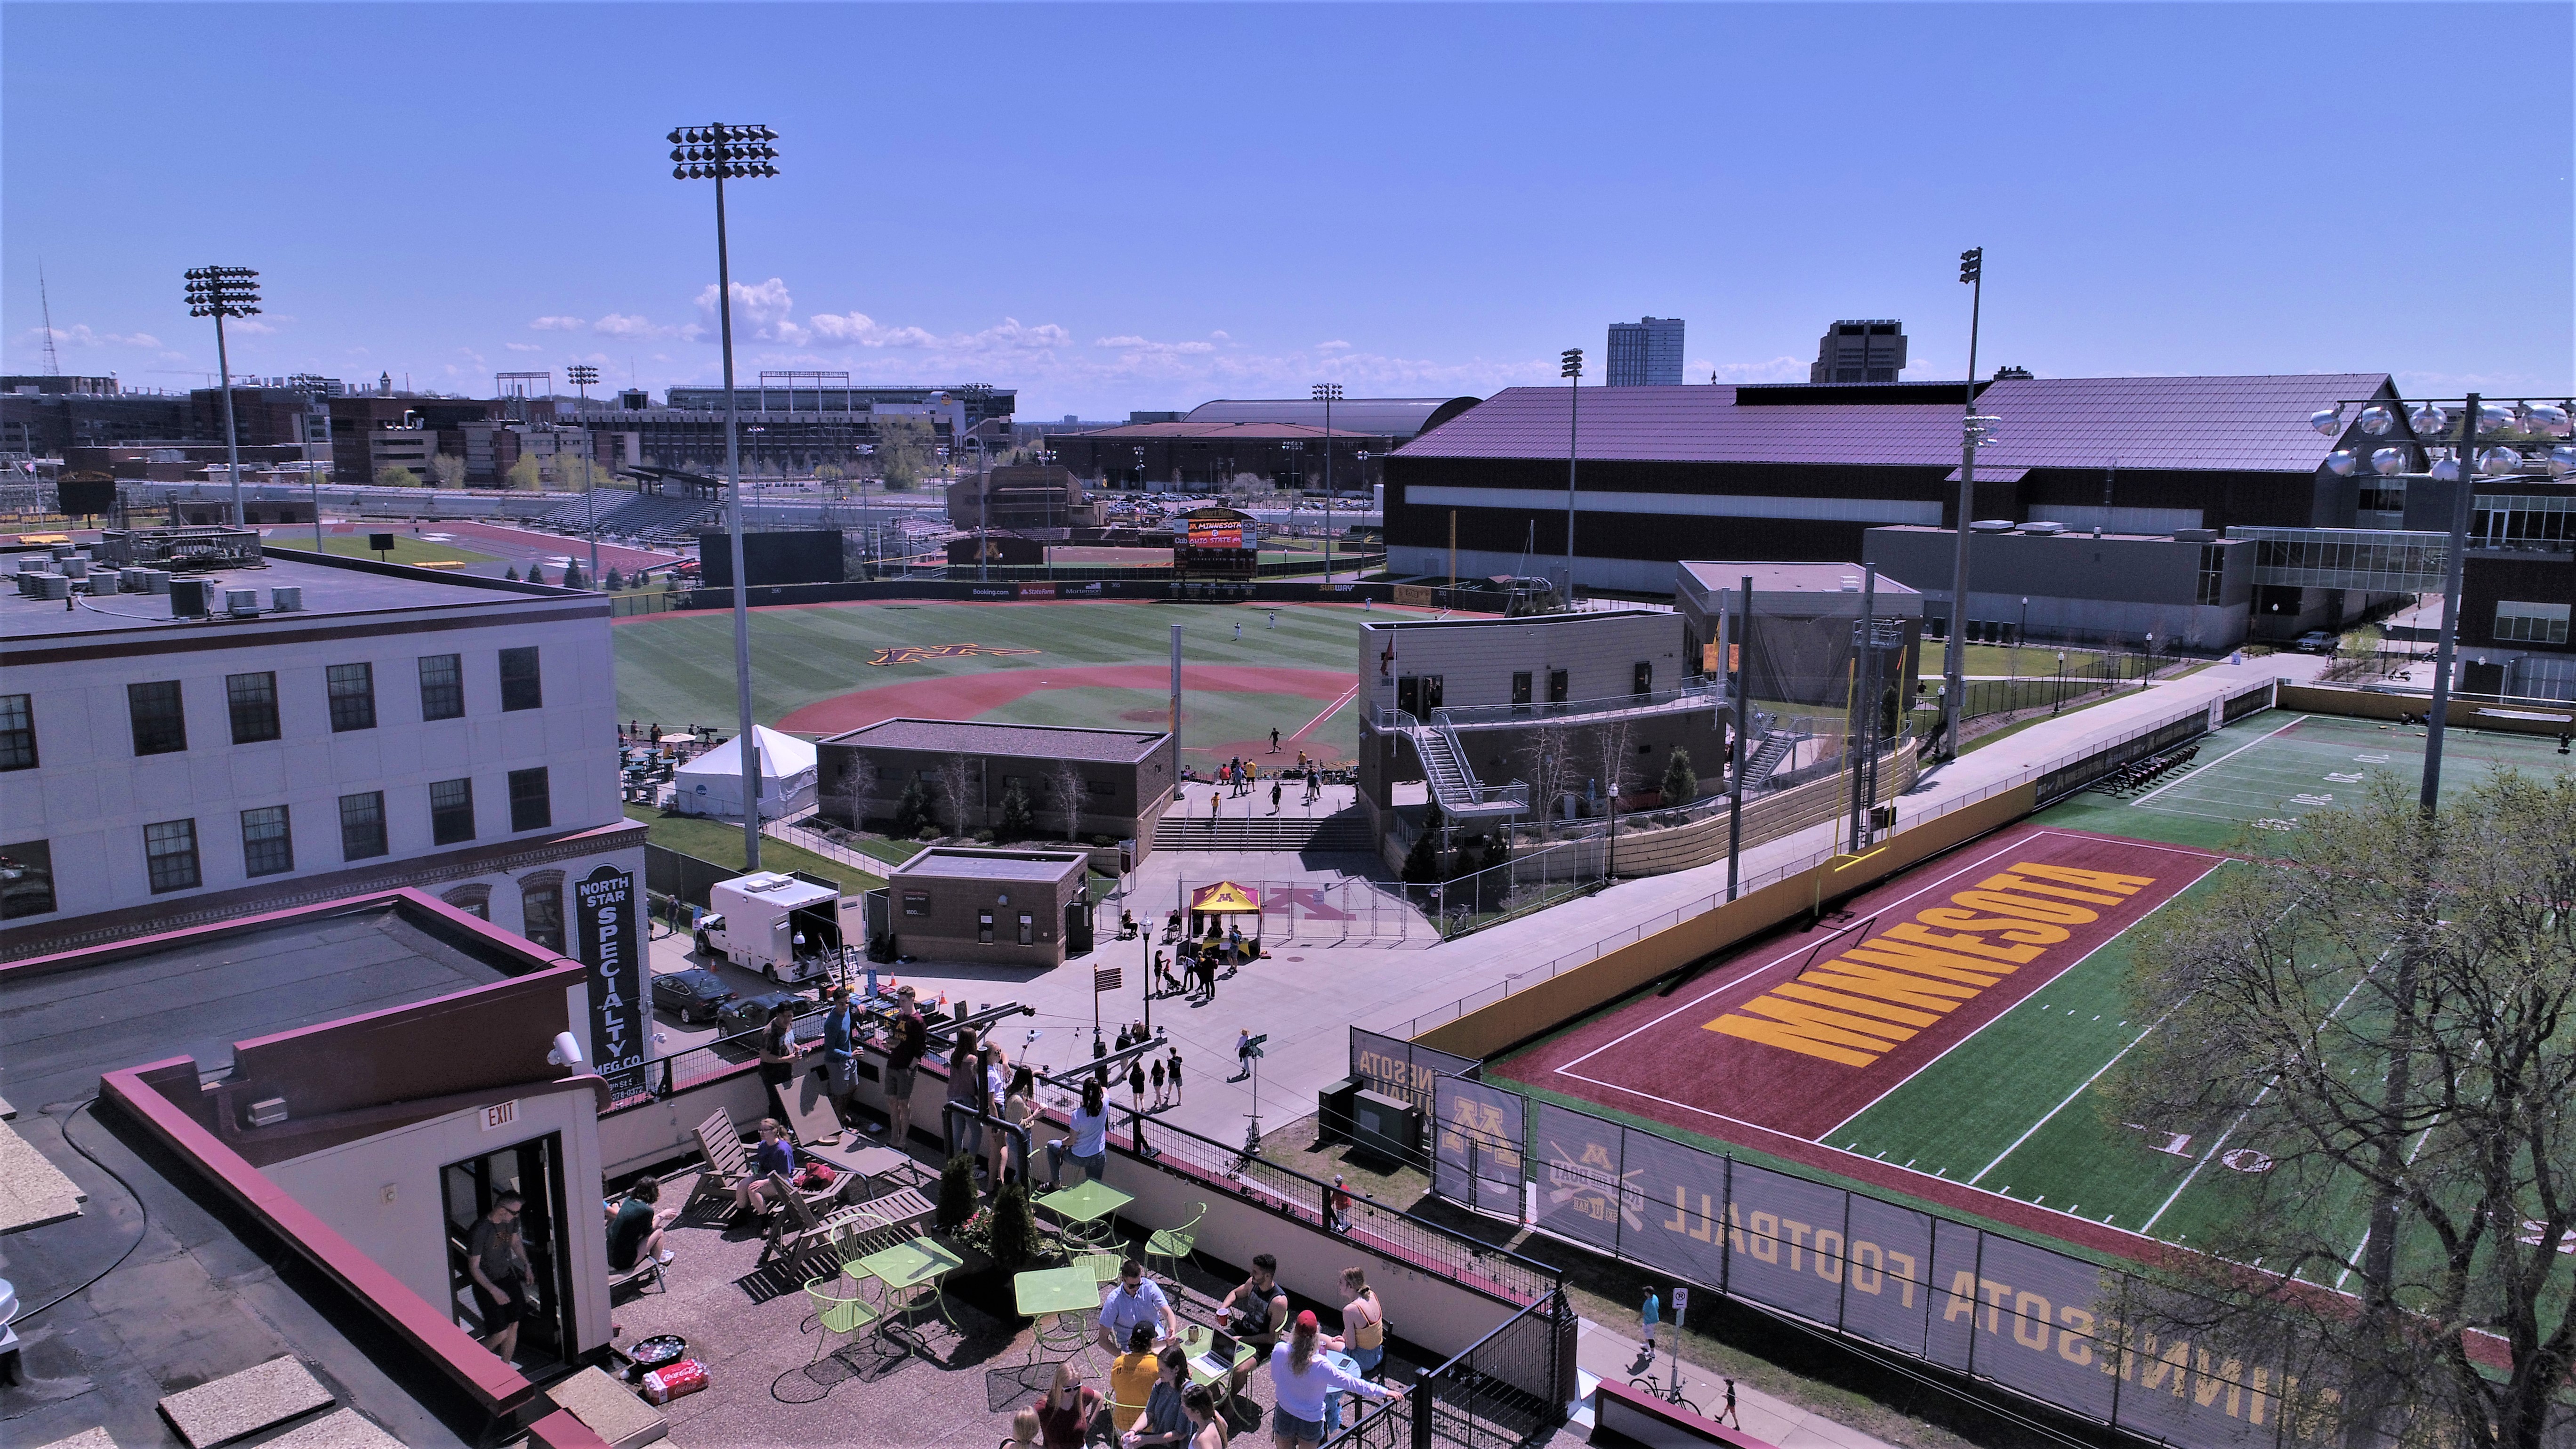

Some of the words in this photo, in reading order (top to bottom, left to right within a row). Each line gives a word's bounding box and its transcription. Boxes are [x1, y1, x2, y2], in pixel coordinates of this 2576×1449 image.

[1198, 522, 1241, 530] MINNESOTA
[580, 877, 628, 896] NORTH
[587, 890, 625, 907] STAR
[1216, 893, 1234, 902] M
[1701, 861, 2155, 1068] MINNESOTA
[597, 907, 627, 1057] SPECIALTY
[489, 1102, 513, 1127] EXIT
[663, 1366, 697, 1382] Coca-Cola
